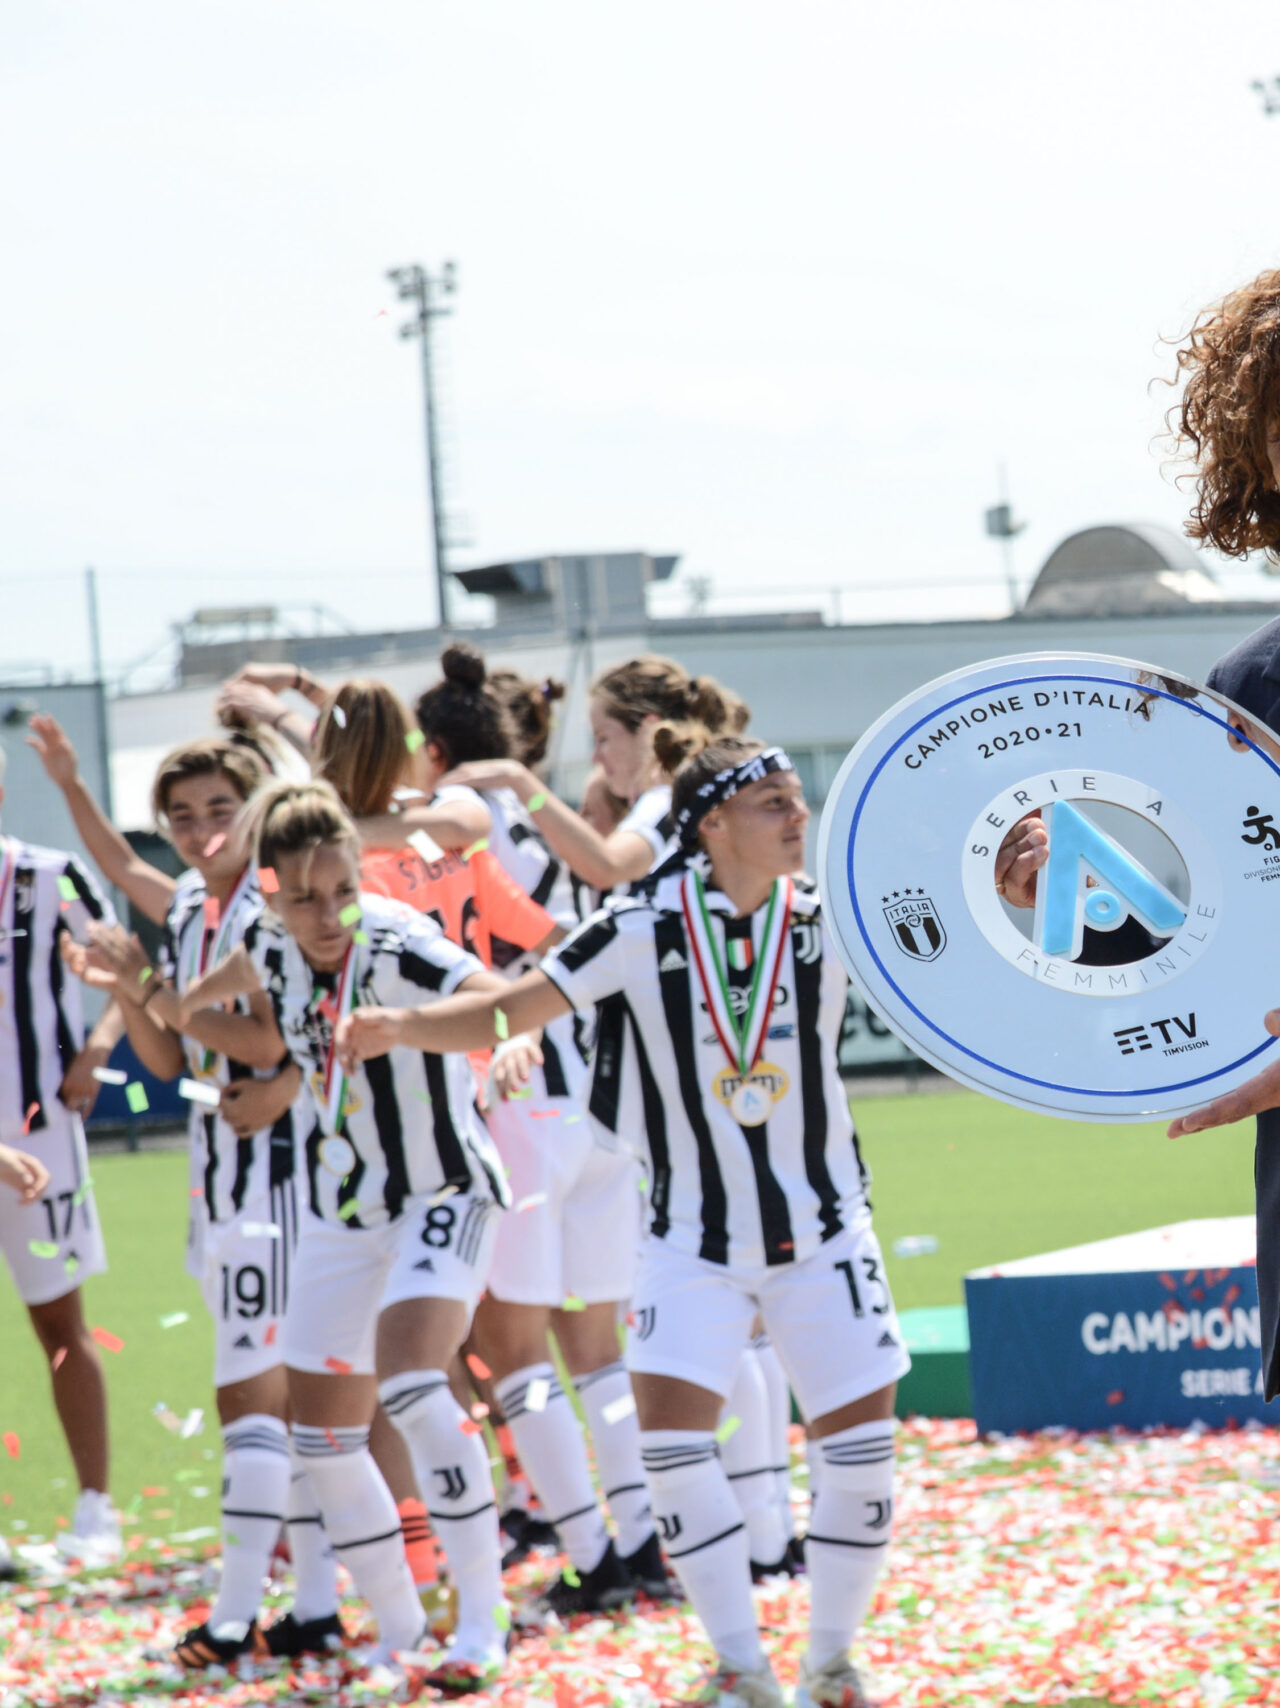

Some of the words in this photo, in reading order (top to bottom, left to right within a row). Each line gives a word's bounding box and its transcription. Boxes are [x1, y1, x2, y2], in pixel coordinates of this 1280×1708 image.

[904, 696, 1024, 770] CAMPIONE
[971, 776, 1097, 857] SERIE
[1146, 800, 1164, 816] A
[889, 902, 930, 920] ITALIA
[1016, 904, 1216, 989] FEMMINILE
[1150, 1012, 1197, 1045] TV
[1162, 1040, 1210, 1057] TIMVISION
[42, 1191, 76, 1242] 17
[421, 1205, 457, 1249] 8
[222, 1264, 266, 1319] 19
[833, 1257, 889, 1318] 13
[1081, 1306, 1262, 1355] CAMPION
[1180, 1368, 1252, 1399] SERIE
